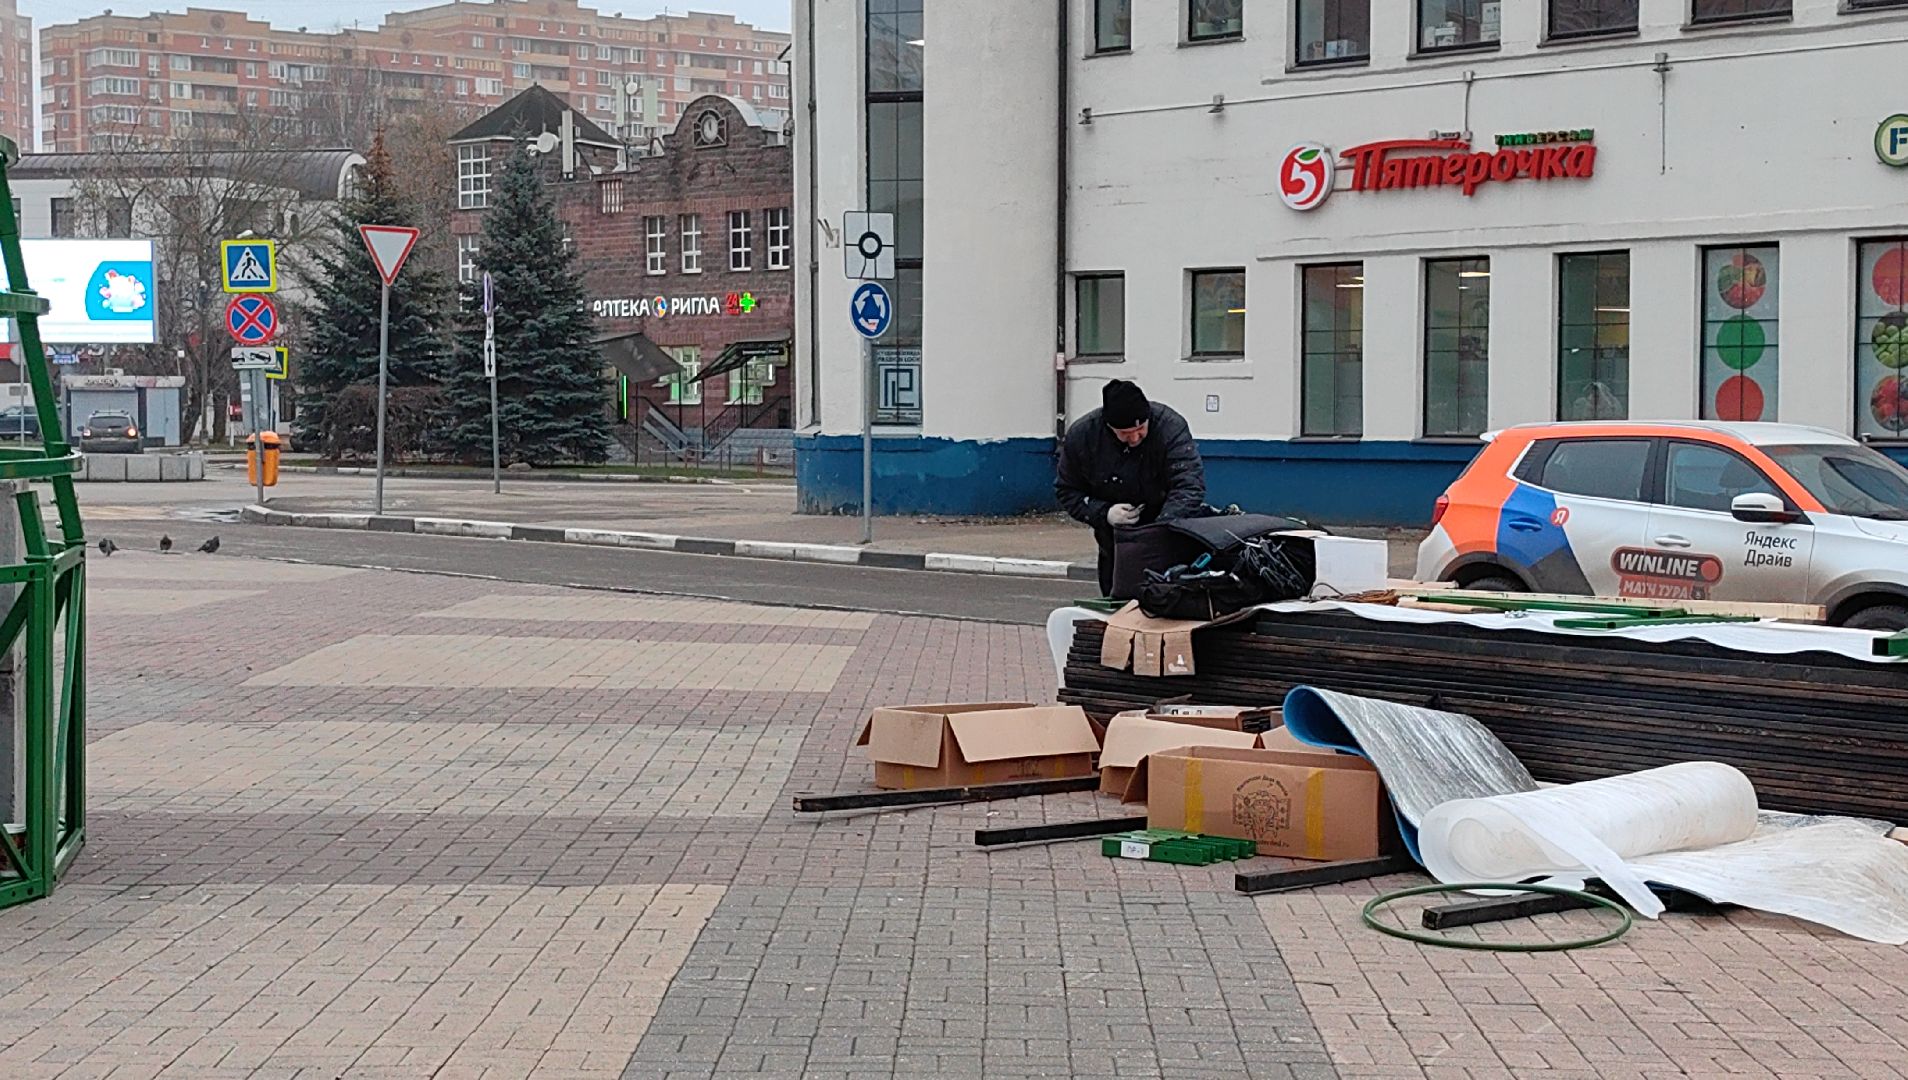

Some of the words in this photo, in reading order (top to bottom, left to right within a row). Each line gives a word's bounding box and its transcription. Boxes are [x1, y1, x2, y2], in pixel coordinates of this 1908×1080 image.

[1340, 139, 1597, 196] Пятерочка
[671, 297, 720, 315] РИГЛА
[1554, 510, 1567, 524] Я
[1744, 531, 1797, 549] Яндекс
[1620, 553, 1699, 577] WINLINE
[1744, 549, 1792, 567] Драйв
[1622, 580, 1656, 596] МАТЧ
[1658, 583, 1689, 599] ТУРА
